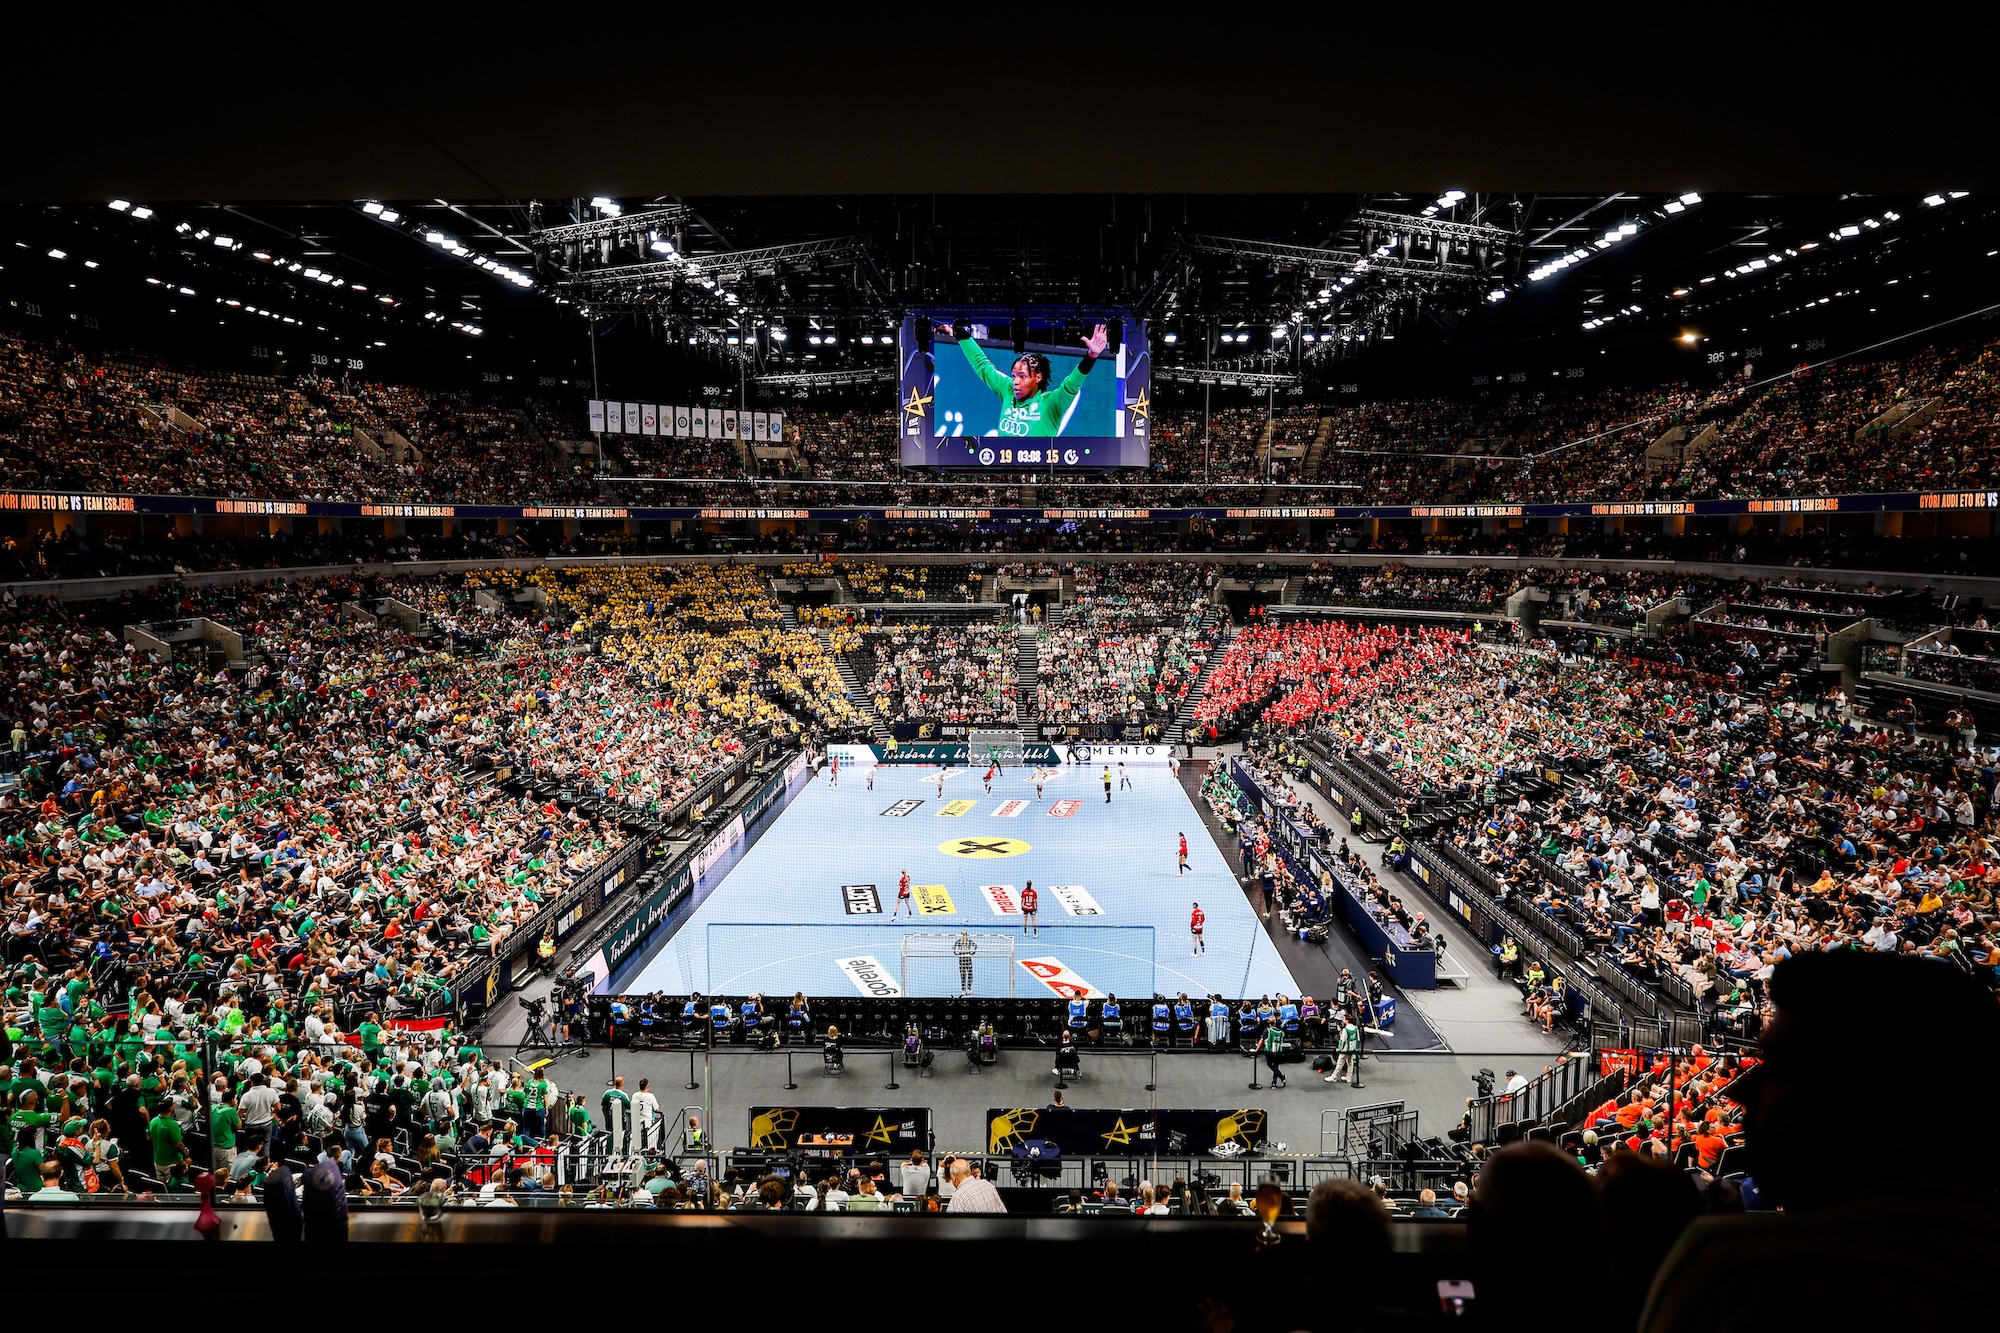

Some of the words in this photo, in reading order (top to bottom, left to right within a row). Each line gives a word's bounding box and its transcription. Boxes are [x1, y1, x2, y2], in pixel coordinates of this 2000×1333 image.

[25, 302, 42, 317] 311
[1805, 340, 1825, 351] 304
[252, 346, 269, 358] 311
[1745, 348, 1762, 359] 304
[311, 354, 328, 365] 310
[1707, 352, 1724, 363] 305
[347, 360, 364, 370] 310
[483, 373, 500, 382] 310
[1509, 372, 1526, 382] 305
[1567, 368, 1584, 379] 305
[538, 377, 555, 387] 309
[703, 386, 720, 396] 309
[1251, 387, 1266, 397] 307
[1340, 384, 1357, 393] 306
[1000, 450, 1012, 463] 19
[1018, 451, 1041, 463] 03:08
[1046, 450, 1060, 463] 15
[21, 495, 40, 509] AUDI
[42, 495, 56, 509] ETO
[58, 496, 68, 509] KC
[70, 496, 81, 510] VS
[83, 497, 103, 510] TEAM
[104, 497, 134, 510] ESBJERG
[1775, 501, 1784, 511] ETO
[1784, 500, 1791, 511] KC
[1792, 500, 1800, 511] VS
[1800, 500, 1814, 511] TEAM
[1815, 498, 1838, 510] ESBJERG
[1941, 494, 1958, 508] AUDI
[1960, 494, 1973, 507] ETO
[1975, 492, 1985, 507] KC
[1987, 492, 1998, 507] VS
[247, 501, 257, 513] ETO
[265, 502, 273, 513] VS
[273, 502, 286, 514] TEAM
[287, 503, 307, 514] ESBJERG
[383, 506, 394, 516] ETO
[395, 506, 403, 516] KC
[404, 506, 413, 516] VS
[413, 506, 429, 516] TEAM
[430, 507, 454, 517] ESBJERG
[1430, 508, 1444, 516] AUDI
[1445, 508, 1456, 516] ETO
[1457, 508, 1466, 516] KC
[1466, 508, 1475, 516] VS
[1476, 507, 1493, 516] TEAM
[1494, 507, 1522, 516] ESBJERG
[1610, 505, 1623, 514] AUDI
[1624, 505, 1635, 514] ETO
[1635, 504, 1645, 514] KC
[1645, 504, 1654, 514] VS
[1655, 503, 1671, 514] TEAM
[553, 509, 565, 517] ETO
[566, 509, 575, 517] KC
[576, 509, 584, 517] VS
[585, 509, 600, 517] TEAM
[602, 509, 627, 517] ESBJERG
[720, 510, 734, 518] AUDI
[735, 510, 746, 518] ETO
[747, 510, 756, 518] KC
[757, 510, 765, 518] VS
[766, 510, 782, 518] TEAM
[783, 510, 809, 518] ESBJERG
[903, 510, 918, 518] AUDI
[918, 510, 929, 518] ETO
[930, 510, 939, 518] KC
[939, 510, 948, 518] VS
[949, 510, 964, 518] TEAM
[965, 510, 991, 518] ESBJERG
[1062, 510, 1077, 518] AUDI
[1077, 510, 1089, 518] ETO
[1089, 510, 1098, 518] KC
[1098, 510, 1107, 518] VS
[1107, 510, 1123, 518] TEAM
[1124, 510, 1150, 518] ESBJERG
[1245, 509, 1259, 517] AUDI
[1260, 509, 1271, 517] ETO
[1272, 509, 1281, 517] KC
[1281, 509, 1290, 517] VS
[1291, 509, 1308, 517] TEAM
[1308, 509, 1335, 517] ESBJERG
[942, 727, 956, 735] DARE
[956, 727, 966, 735] TO
[1067, 727, 1080, 735] RISE
[1093, 746, 1156, 755] MENTO
[988, 886, 1019, 914] mateco
[1025, 896, 1033, 904] 18
[845, 959, 898, 996] gorenje
[528, 1087, 538, 1097] 23
[1140, 1132, 1156, 1140] FINA4
